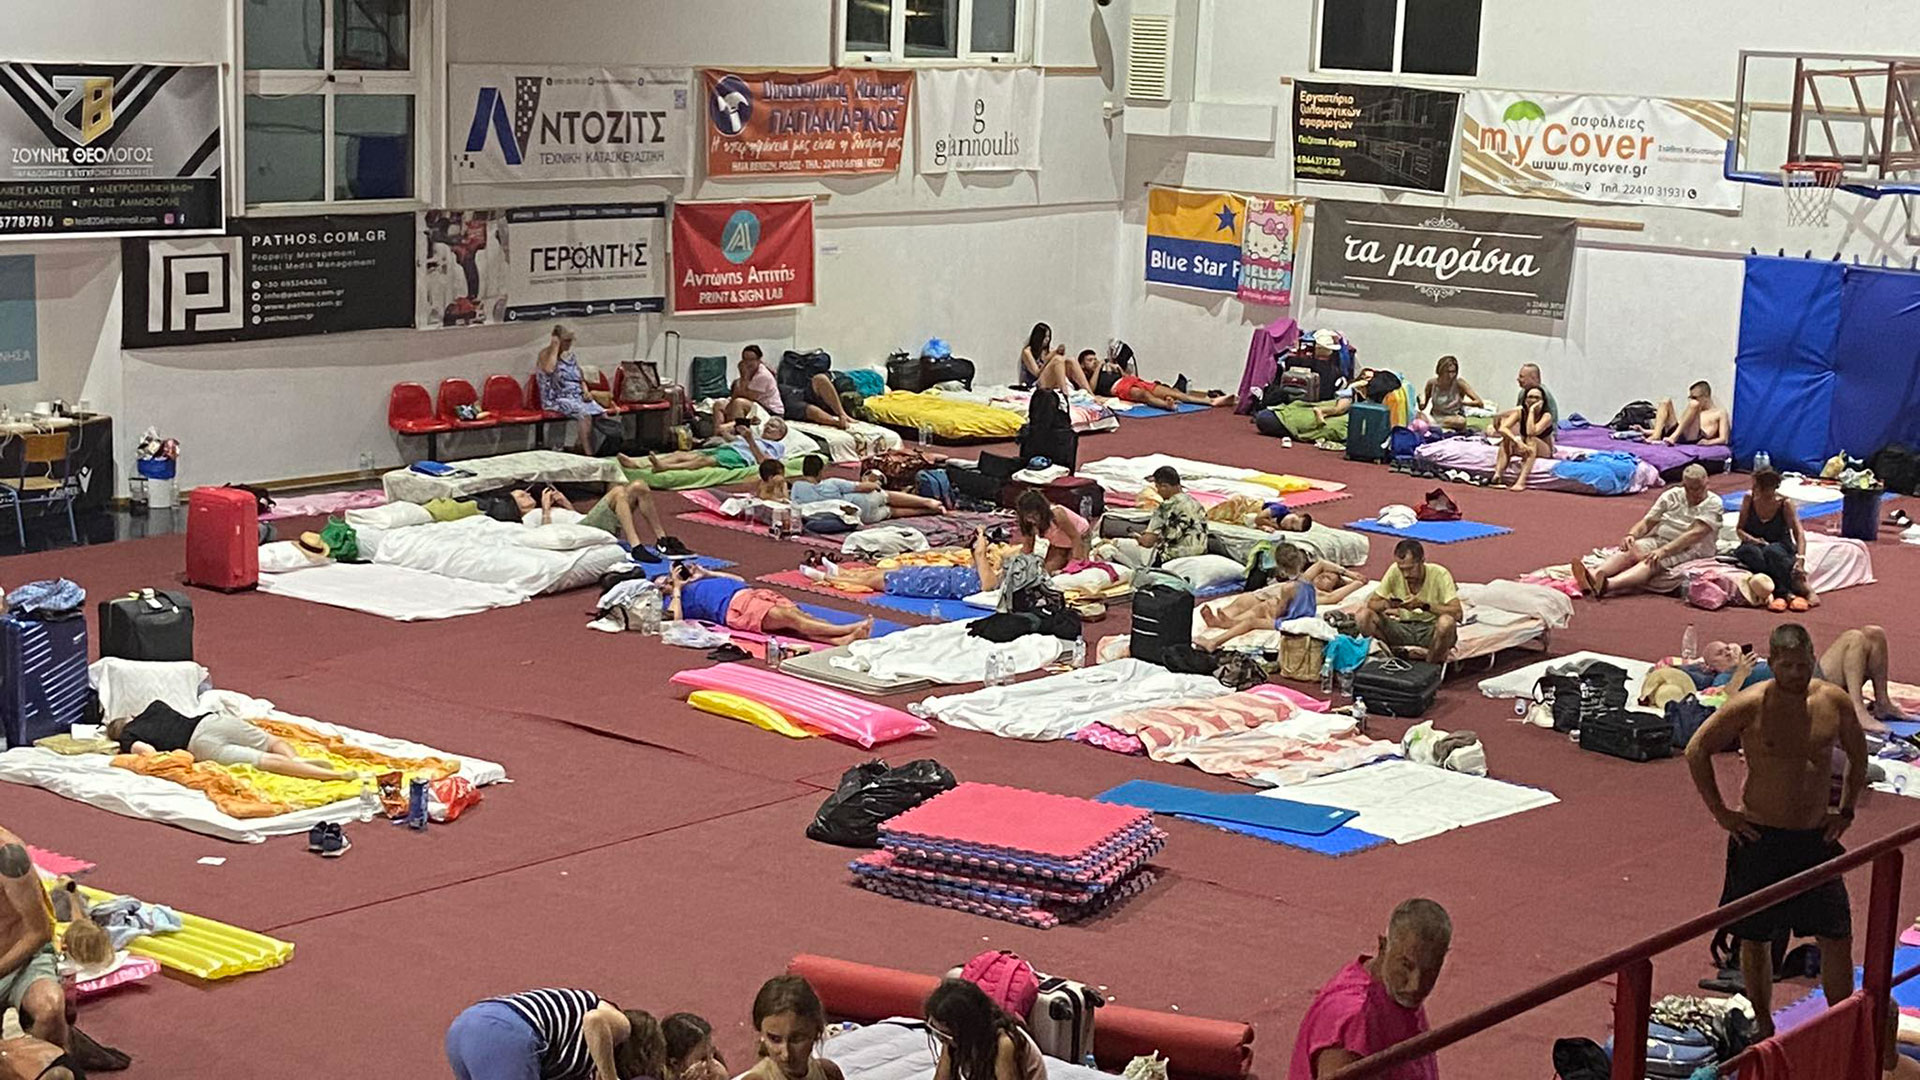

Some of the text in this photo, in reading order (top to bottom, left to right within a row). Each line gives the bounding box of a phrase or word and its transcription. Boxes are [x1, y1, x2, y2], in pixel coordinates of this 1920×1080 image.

[1300, 90, 1355, 106] Εργαστήριο
[769, 106, 900, 134] ΠΑΠΑΜΑΡΚΟΣ
[972, 98, 986, 135] g
[1299, 118, 1354, 131] εφαρμογών
[1570, 115, 1646, 133] ασφάλειες
[540, 110, 667, 145] ΝΤΟΖΙΤΣ
[934, 131, 1020, 166] giannoulis
[1479, 122, 1655, 167] my Cover
[12, 147, 154, 164] ΖΟΥΝΗΣ ΘΕΟΛΟΓΟΣ
[540, 151, 666, 165] ΤΕΧΝΙΚΗ ΚΑΤΑΣΚΕΥΑΣΤΙΚΗ
[1531, 160, 1649, 179] www.mycover.gr
[27, 185, 81, 195] ΚΑΤΑΣΚΕΥΕΣ
[1623, 184, 1654, 196] 22410
[1656, 187, 1686, 198] 31931
[78, 198, 180, 208] ΕΡΓΑΣΙΕΣ ΑΜΜΟΒΟΛΗΣ
[252, 230, 387, 247] PATHOS.COM.GR
[251, 249, 357, 261] Property Management
[530, 243, 648, 273] ΓΕΡΟΝΤΗΣ
[1151, 250, 1188, 271] Blue
[1193, 255, 1228, 277] Star
[1343, 234, 1541, 281] τα μαράσια
[251, 258, 376, 272] Social Media Management
[682, 267, 743, 288] Αντώνης
[699, 287, 783, 305] PRINT & SIGN LAB
